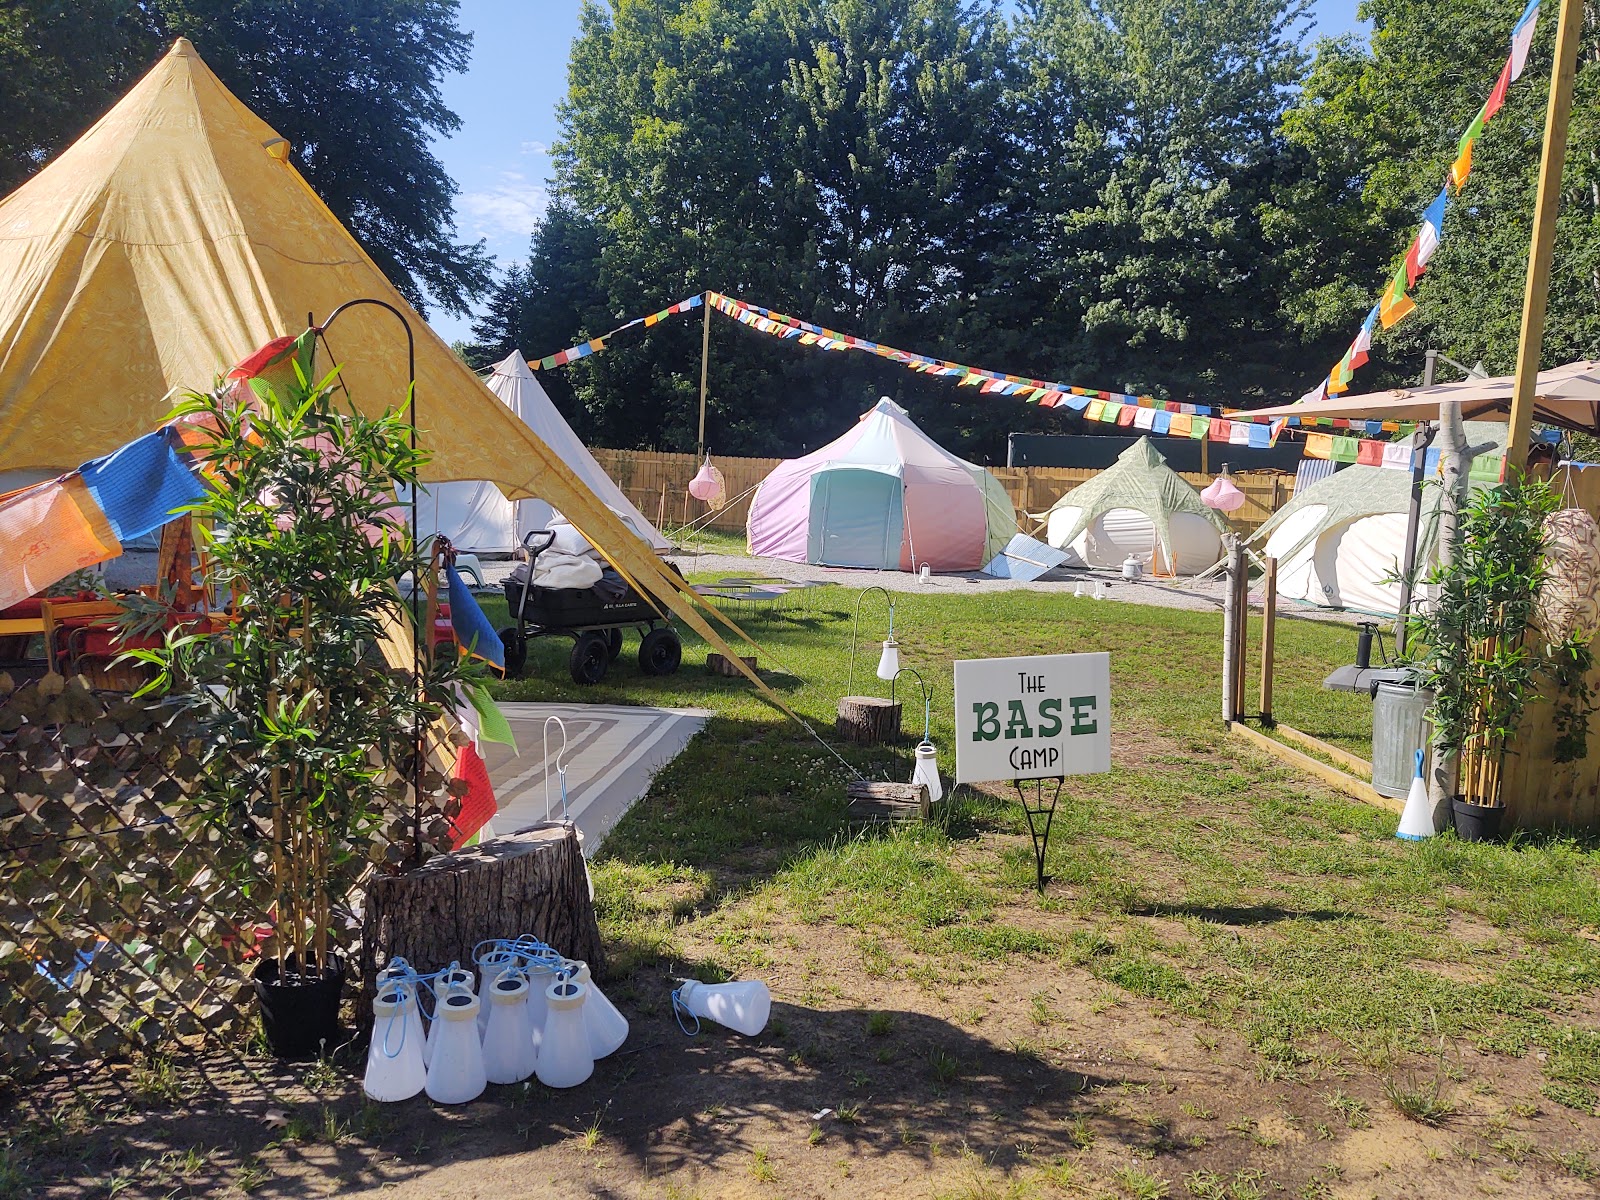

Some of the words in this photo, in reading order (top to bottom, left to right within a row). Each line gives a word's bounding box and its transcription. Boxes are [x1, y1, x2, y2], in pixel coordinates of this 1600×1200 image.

[1018, 672, 1046, 694] THE
[972, 695, 1098, 742] BASE
[1009, 746, 1059, 771] CAMP
